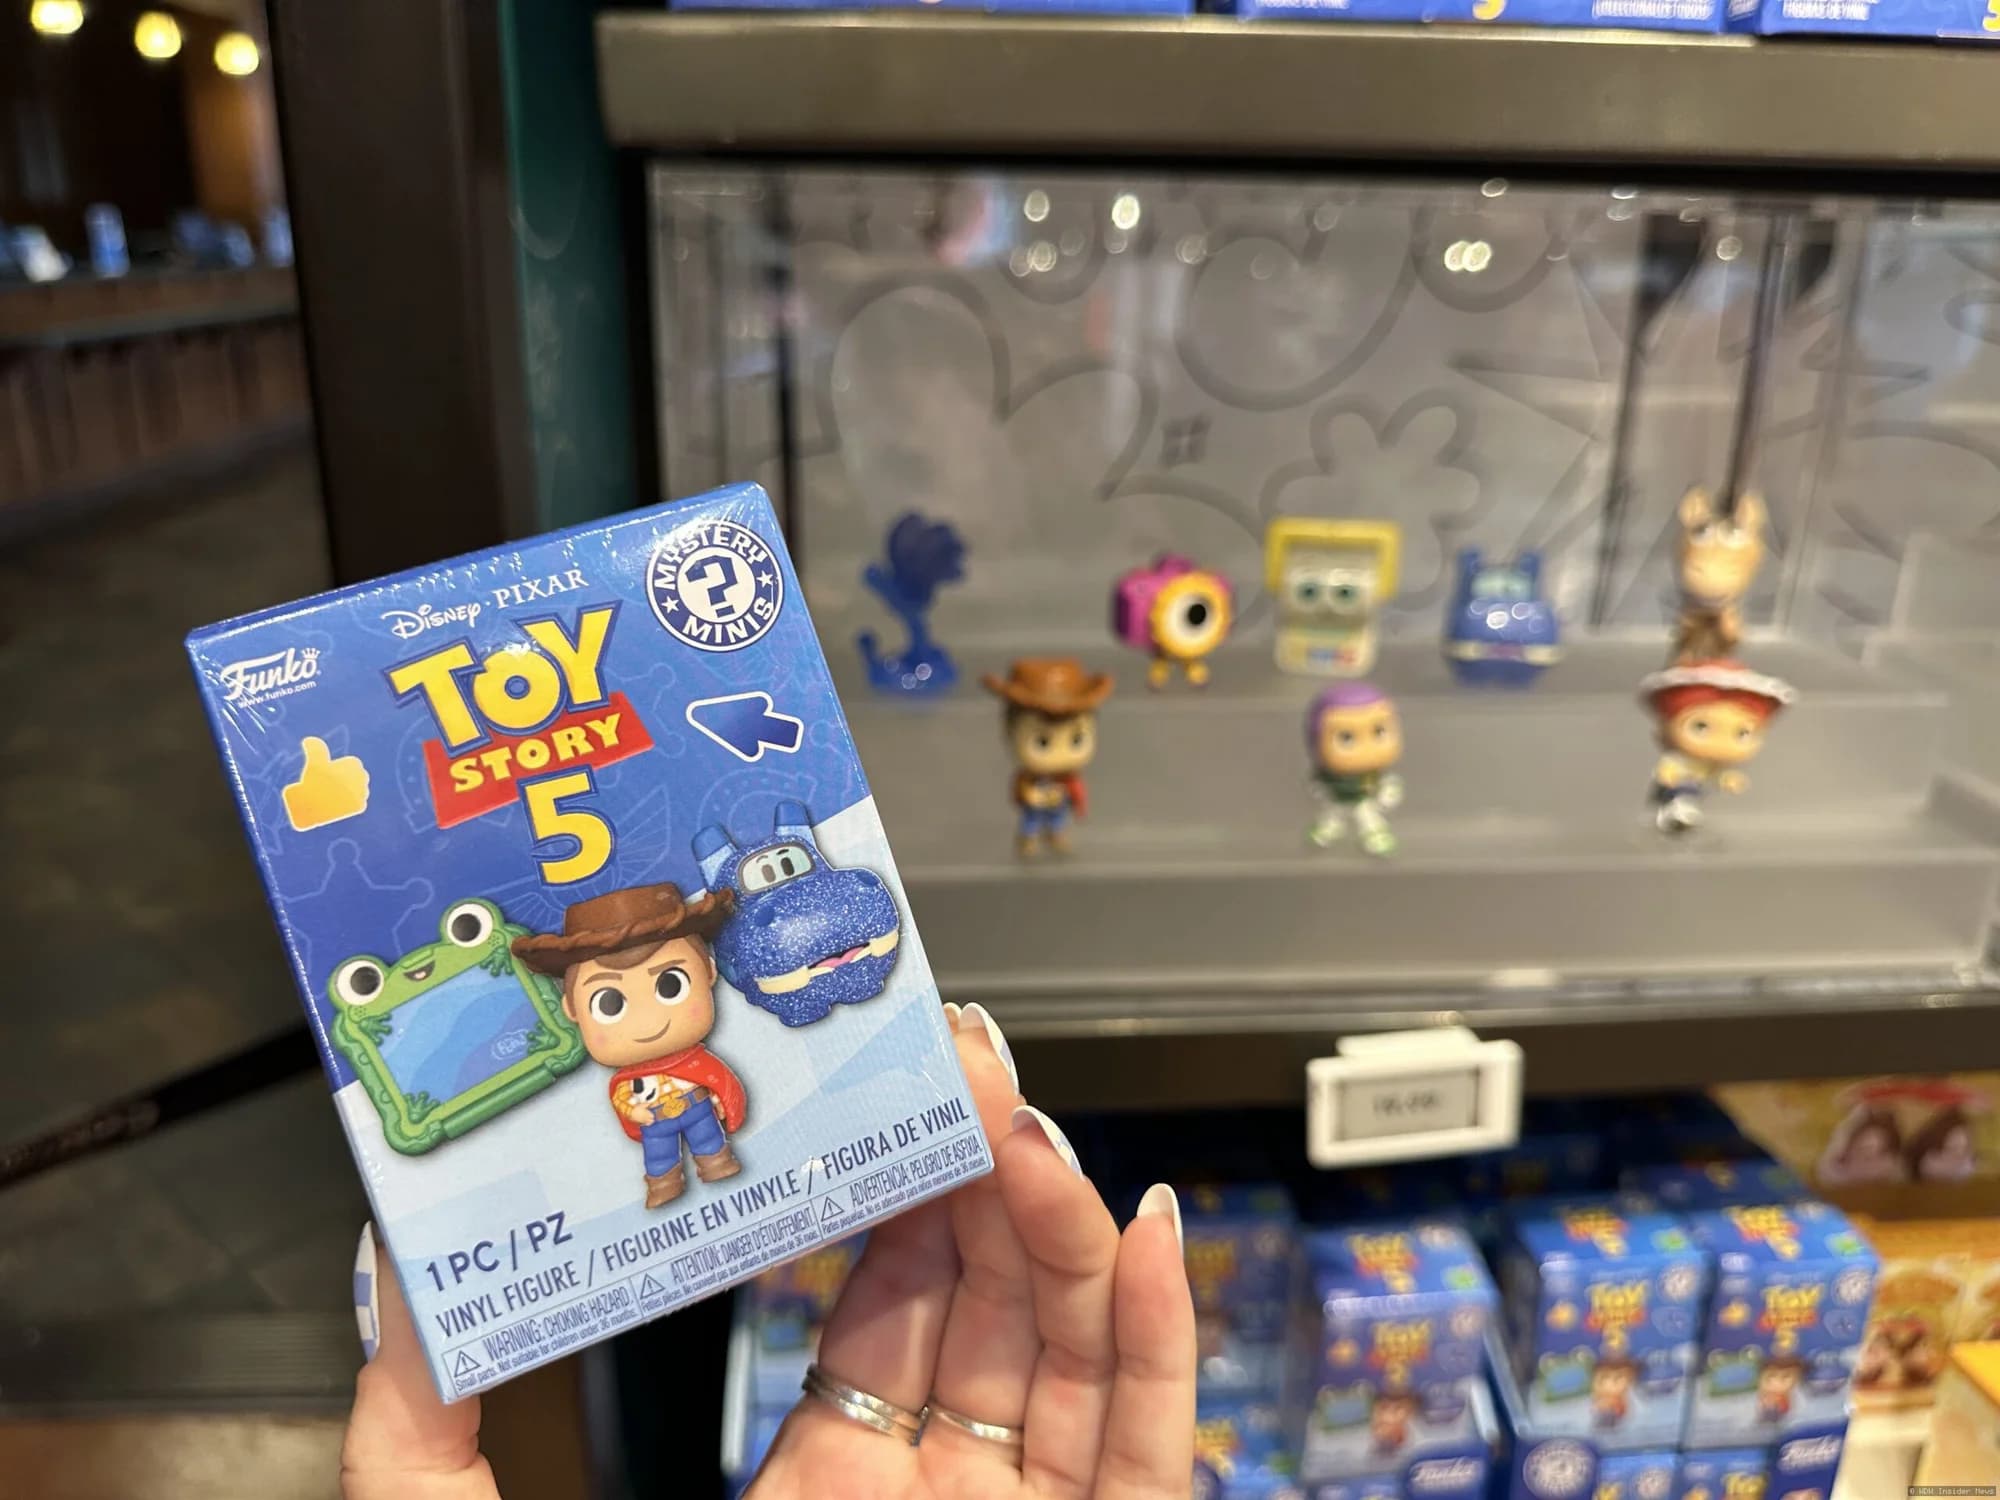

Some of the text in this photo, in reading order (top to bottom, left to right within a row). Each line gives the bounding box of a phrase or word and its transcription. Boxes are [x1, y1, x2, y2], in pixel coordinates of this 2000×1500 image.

[491, 568, 590, 609] PIXAR
[655, 525, 768, 591] MYSTERY
[681, 596, 774, 643] MINIS
[220, 648, 319, 701] Funko
[237, 680, 318, 709] www.funko.com
[384, 604, 618, 755] TOY
[449, 712, 622, 793] STORY
[521, 769, 616, 885] 5
[850, 1162, 911, 1206] ADVERTENCIA:
[911, 1151, 942, 1180] PELIGRO
[941, 1146, 953, 1166] DE
[865, 1203, 874, 1214] No
[874, 1201, 881, 1211] es
[905, 1185, 918, 1199] para
[952, 1164, 961, 1176] de
[435, 1292, 502, 1338] VINYL
[503, 1260, 581, 1312] FIGURE
[586, 1249, 595, 1288] /
[601, 1211, 699, 1272] FIGURINE
[700, 1199, 730, 1232] EN
[729, 1171, 801, 1217] VINYLE
[821, 1130, 893, 1180] FIGURA
[893, 1116, 921, 1149] DE
[919, 1096, 970, 1135] VINIL
[426, 1210, 574, 1292] 1 PC / PZ
[671, 1244, 722, 1283] ATTENTION:
[722, 1233, 754, 1263] DANGER
[716, 1267, 729, 1282] pas
[728, 1263, 739, 1276] aux
[738, 1252, 760, 1271] enfants
[760, 1249, 769, 1261] de
[786, 1238, 795, 1250] de
[455, 1374, 477, 1391] Small
[497, 1358, 512, 1372] Not
[510, 1346, 540, 1367] suitable
[538, 1341, 550, 1355] for
[549, 1330, 579, 1350] children
[578, 1322, 598, 1338] under
[598, 1317, 610, 1330] 36
[485, 1284, 633, 1361] WARNING: CHOKING HAZARD.
